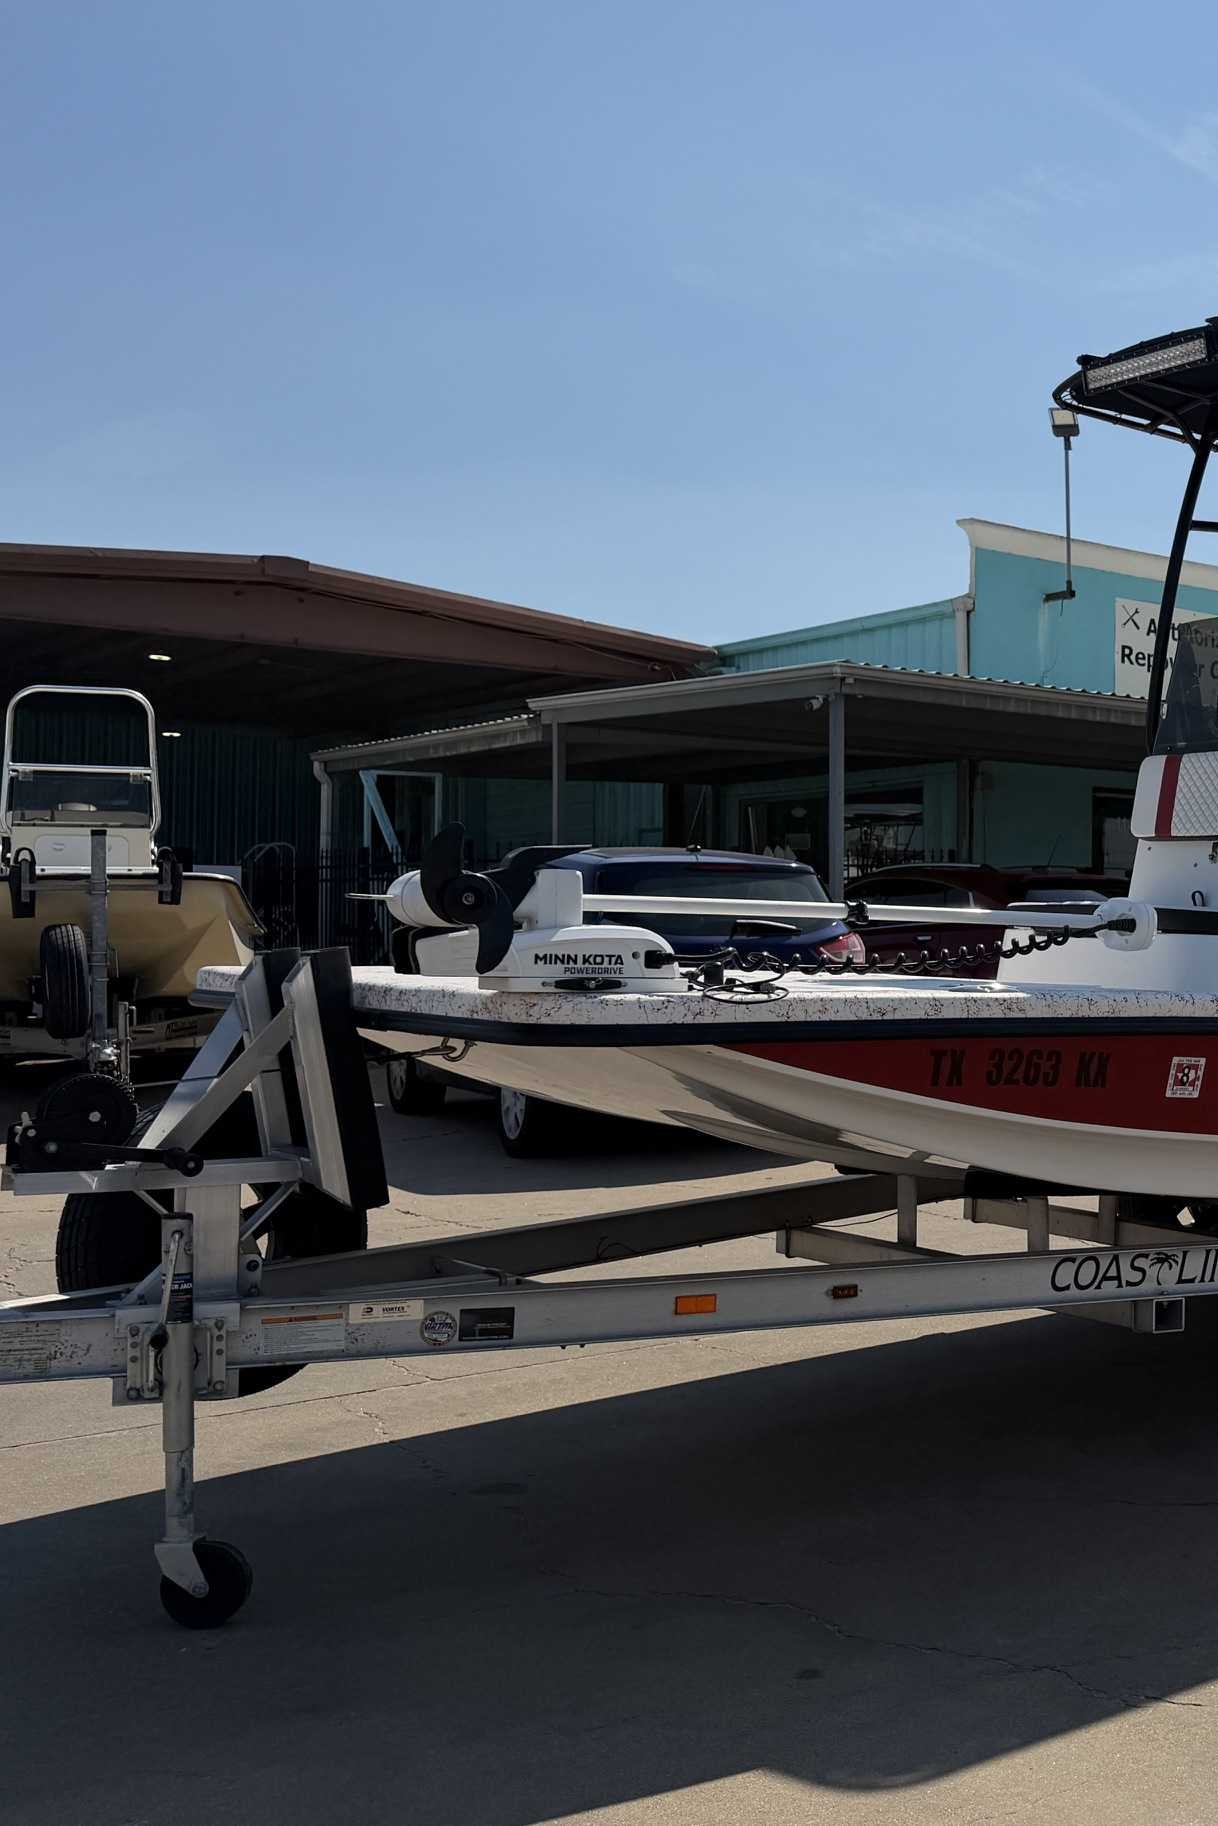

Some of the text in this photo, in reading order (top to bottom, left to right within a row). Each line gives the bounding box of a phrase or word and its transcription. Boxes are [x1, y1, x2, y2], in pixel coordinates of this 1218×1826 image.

[534, 953, 624, 966] MINN KOTA
[563, 966, 624, 975] POWERDRIVE
[929, 1048, 966, 1087] TX
[986, 1047, 1063, 1088] 3263
